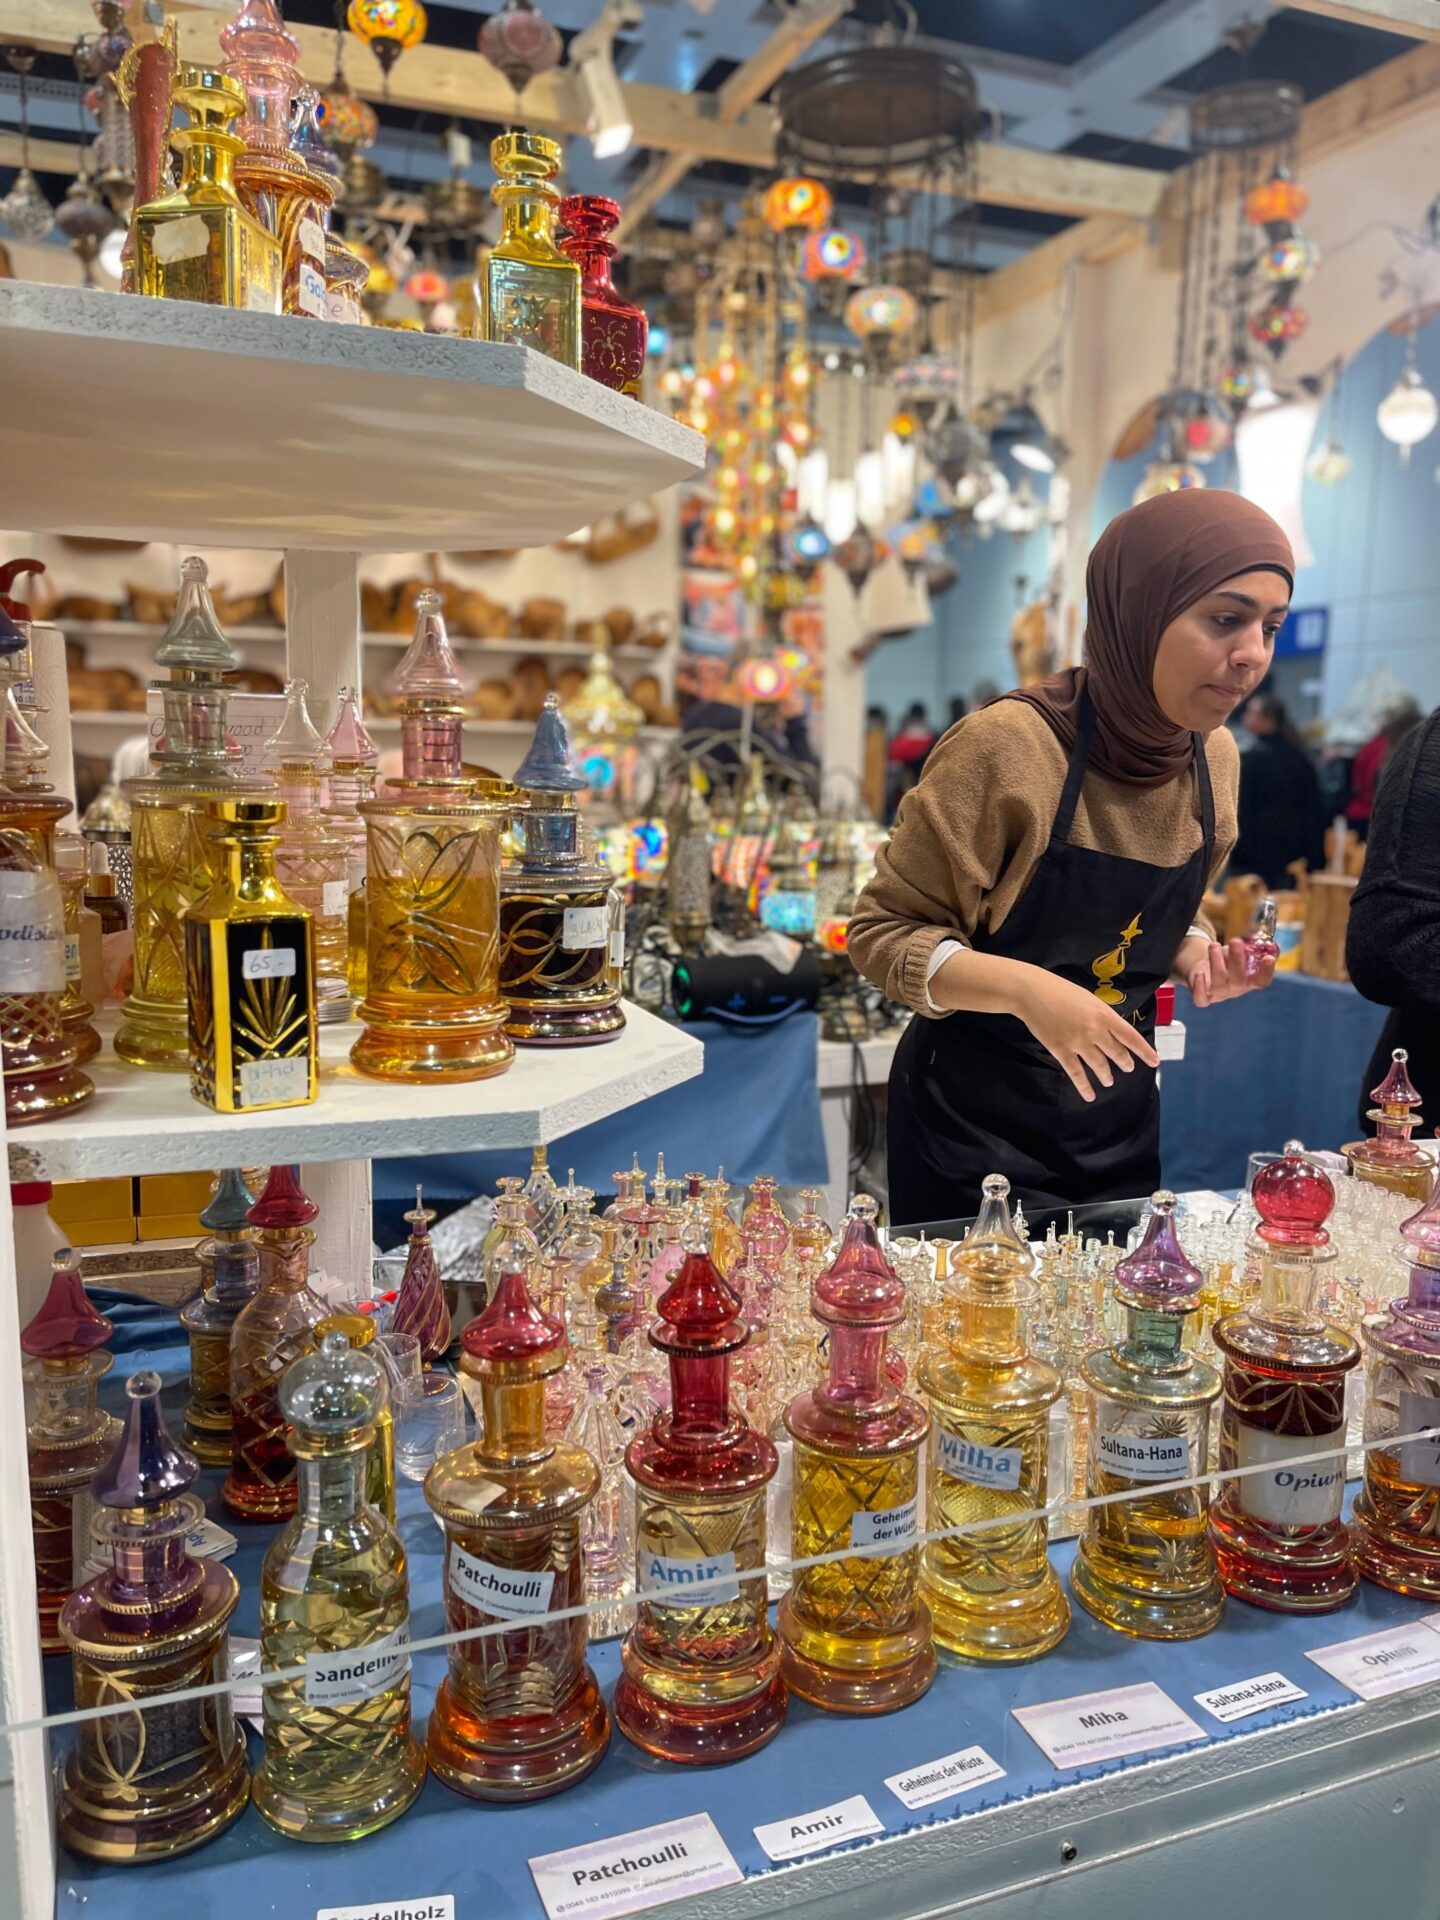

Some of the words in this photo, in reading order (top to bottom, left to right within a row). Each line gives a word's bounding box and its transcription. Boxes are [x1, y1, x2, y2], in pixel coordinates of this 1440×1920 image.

[938, 1433, 1011, 1472] Milha
[1101, 1436, 1183, 1460] Sultana-Hana
[1274, 1470, 1343, 1492] Opium
[873, 1529, 892, 1540] der
[894, 1519, 916, 1537] Wüst
[457, 1557, 542, 1598] Patchoulli
[650, 1559, 718, 1584] Amir
[1361, 1646, 1418, 1667] Opium
[1206, 1680, 1287, 1708] Sultana-Hana
[1078, 1710, 1129, 1728] Miha
[898, 1770, 946, 1792] Geheimnis
[943, 1765, 958, 1777] der
[954, 1756, 985, 1772] Wüste
[790, 1815, 843, 1839] Amir
[572, 1842, 688, 1886] Patchoulli
